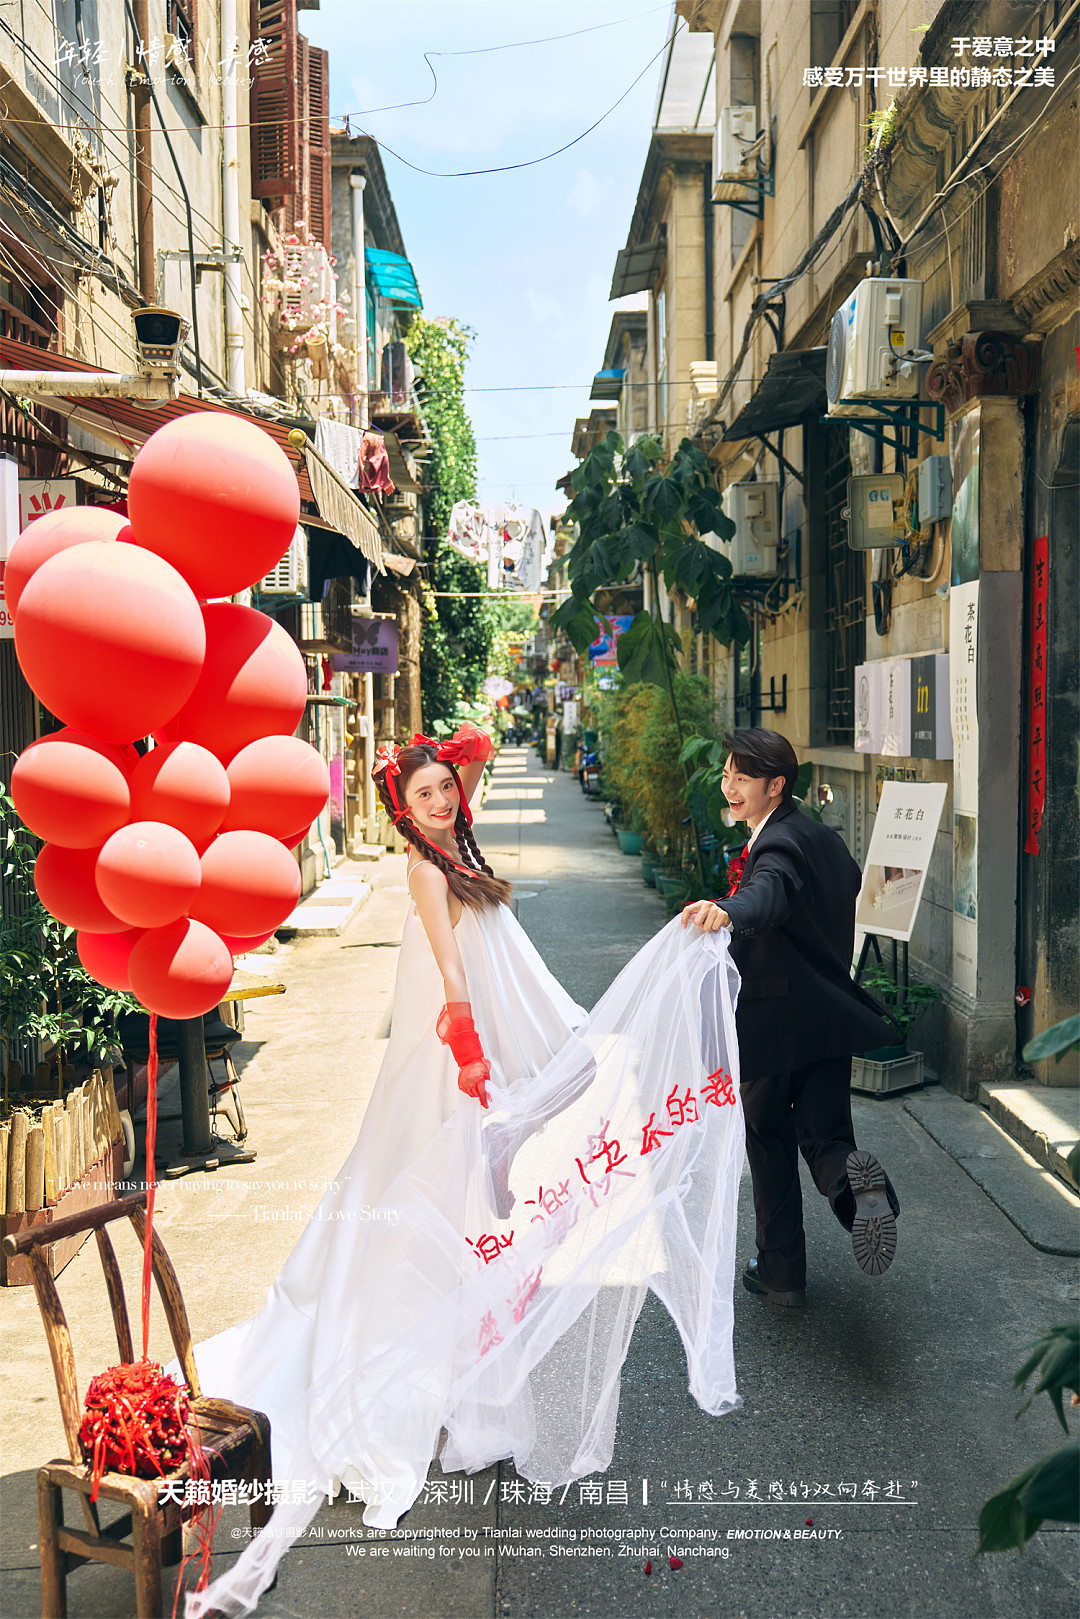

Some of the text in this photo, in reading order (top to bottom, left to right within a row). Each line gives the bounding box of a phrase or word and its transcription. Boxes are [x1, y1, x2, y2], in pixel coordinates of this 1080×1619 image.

[964, 601, 975, 664] 茶花白
[917, 676, 929, 714] in
[893, 807, 925, 822] 茶花白
